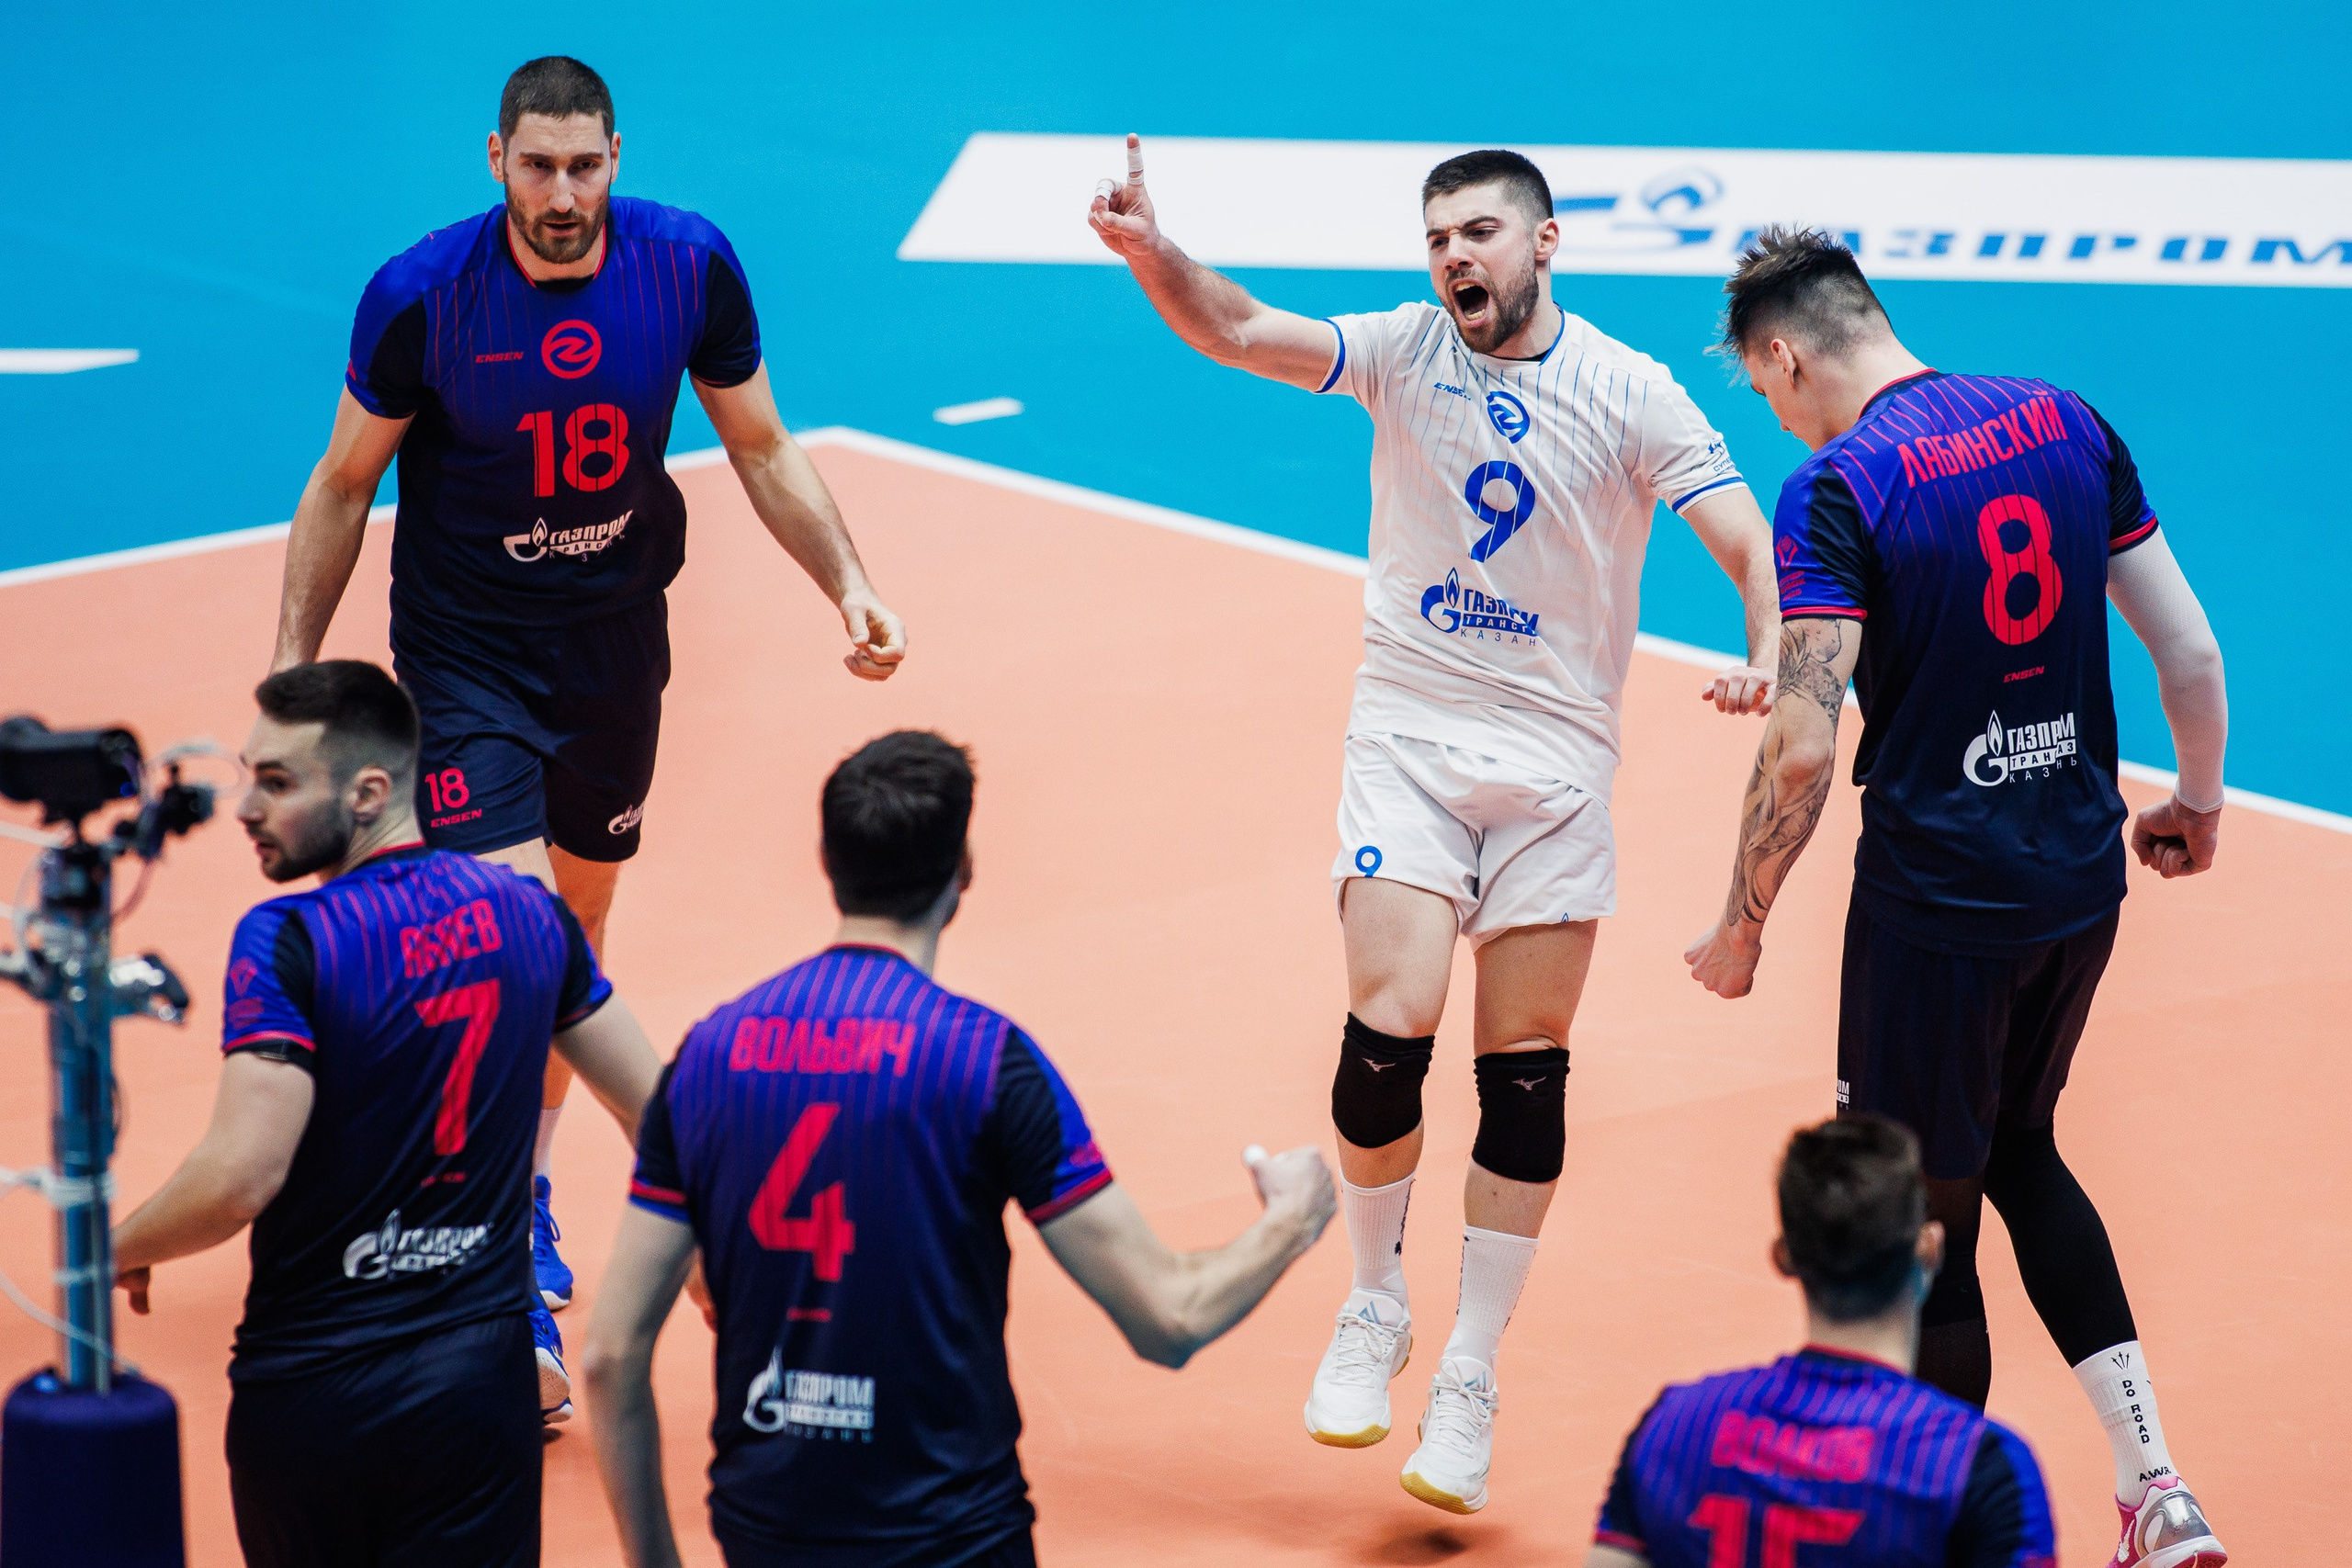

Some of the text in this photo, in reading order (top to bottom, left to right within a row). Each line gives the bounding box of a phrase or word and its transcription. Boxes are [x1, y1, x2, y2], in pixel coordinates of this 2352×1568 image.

[475, 352, 524, 363] ENSEN
[516, 403, 629, 497] 18
[1897, 390, 2068, 488] ЛАБИНСКИЙ
[1464, 460, 1535, 562] 9
[1977, 494, 2063, 645] 8
[1460, 628, 1537, 646] КАЗАН
[2004, 666, 2045, 682] ENSEN
[2007, 712, 2075, 753] ГАЗПРМ
[424, 768, 469, 812] 18
[430, 808, 482, 828] ENSEN
[1354, 845, 1383, 878] 9
[413, 979, 501, 1156] 7
[729, 1015, 917, 1078] ВОЛЬВИЧ
[748, 1101, 855, 1282] 4
[2131, 1404, 2151, 1445] ROAD
